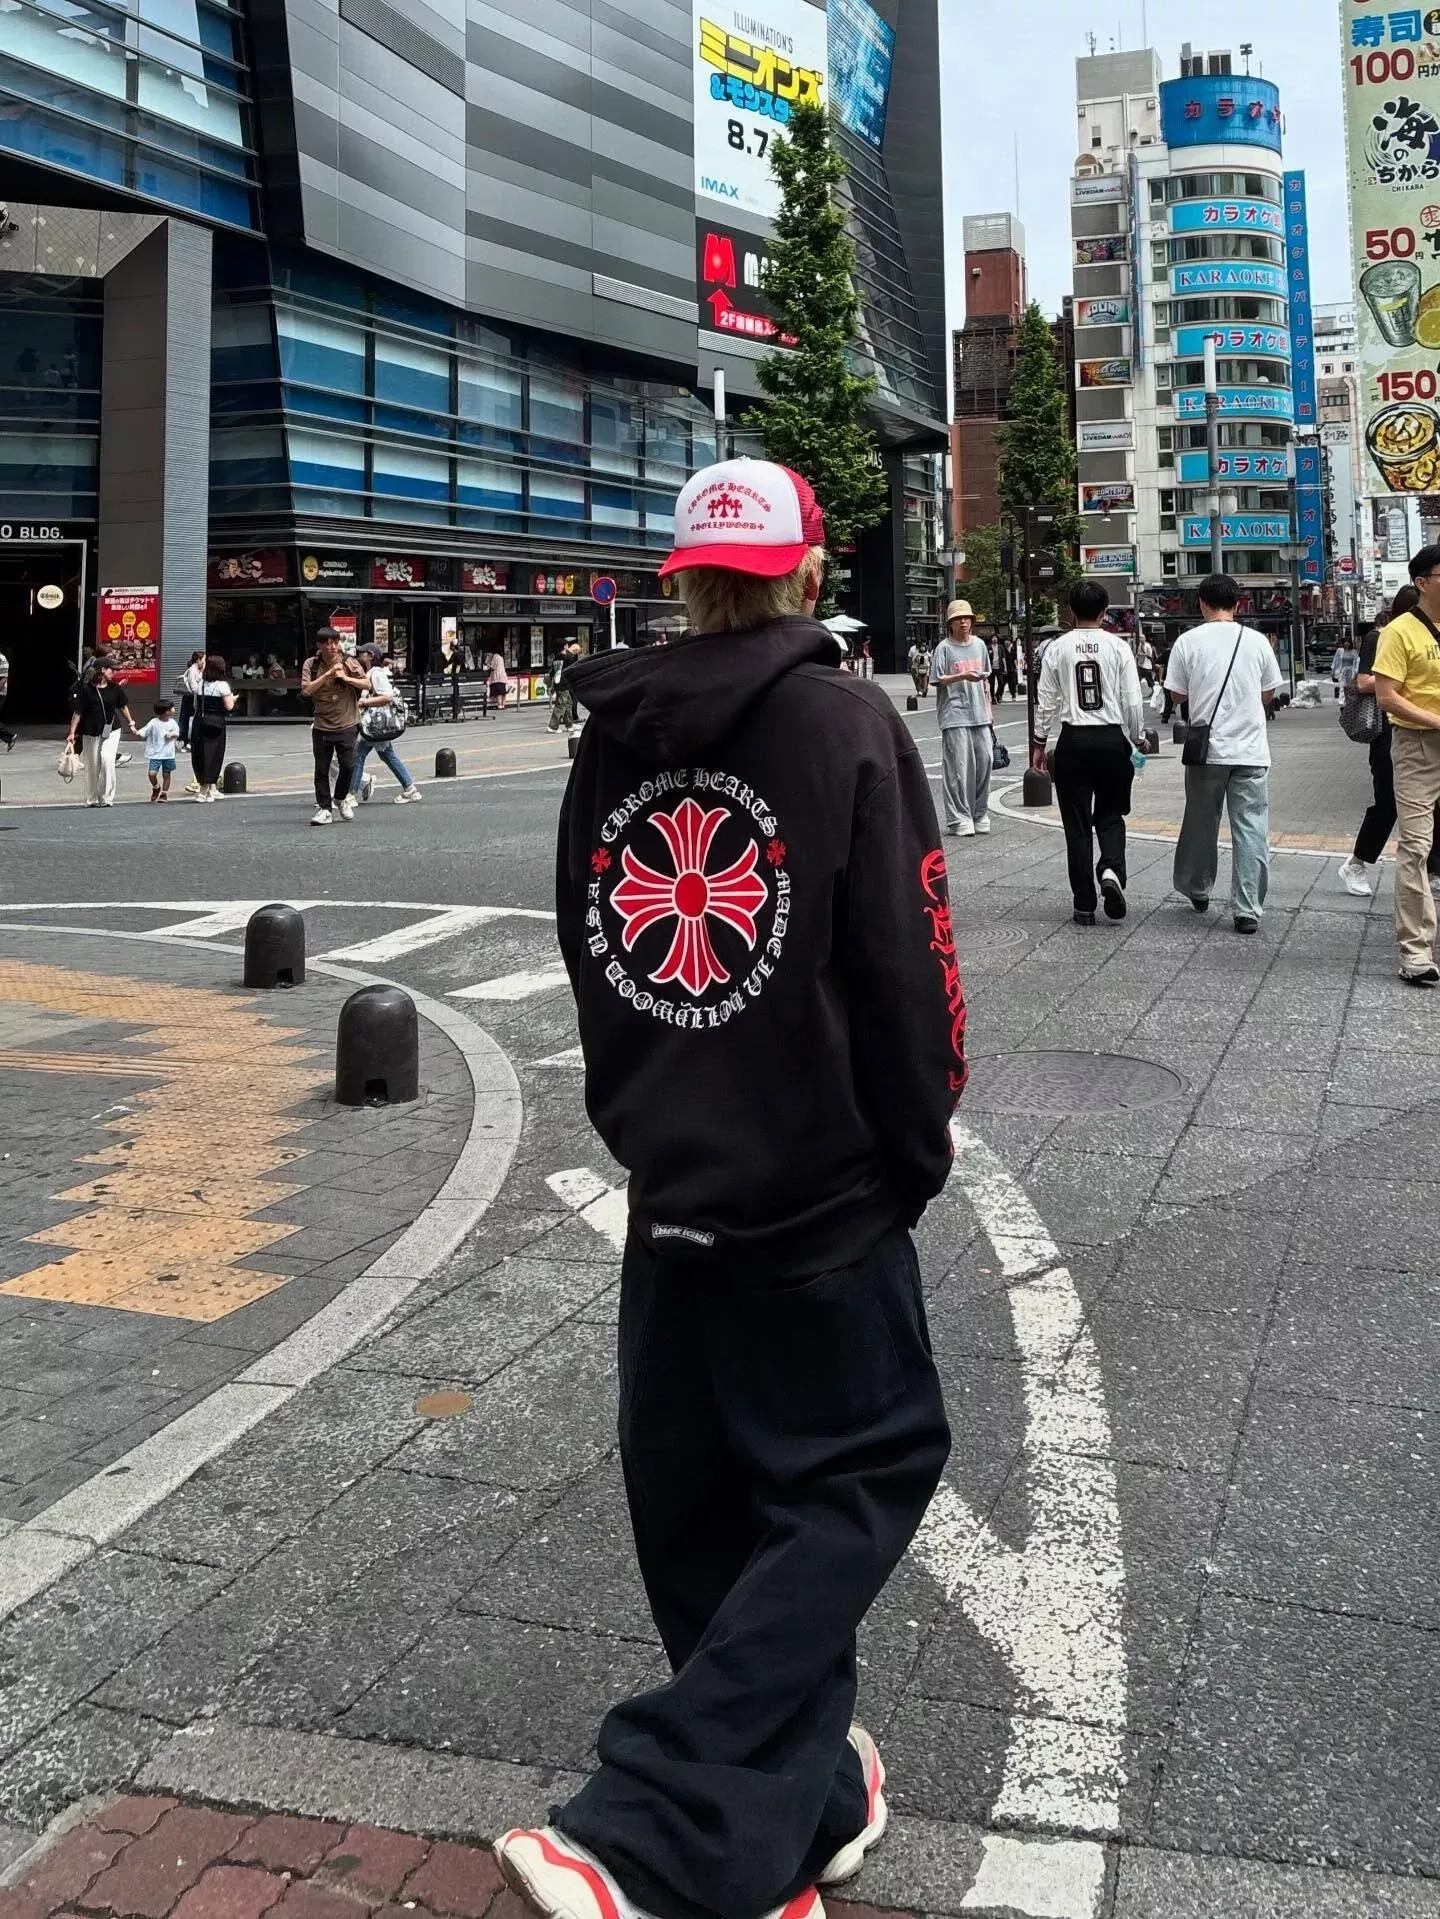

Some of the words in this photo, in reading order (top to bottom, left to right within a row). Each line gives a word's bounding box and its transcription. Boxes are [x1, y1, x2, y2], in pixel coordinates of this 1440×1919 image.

[733, 11, 794, 53] ILLUMINATION'S
[1352, 10, 1422, 47] 寿司
[699, 16, 823, 109] ミニオンズ
[1350, 48, 1415, 85] 100
[701, 176, 739, 200] IMAX
[1392, 184, 1424, 192] CHIKARA
[1366, 227, 1416, 260] 50
[1376, 369, 1437, 401] 150
[1184, 395, 1277, 410] KRAOKE
[1218, 457, 1288, 477] カラオケ
[727, 482, 772, 513] HEARTS
[20, 527, 64, 539] BLDG.
[695, 521, 757, 531] HOLLYWOOD
[1075, 661, 1104, 711] 8
[600, 768, 688, 842] CHROME
[692, 768, 778, 837] HEARTS
